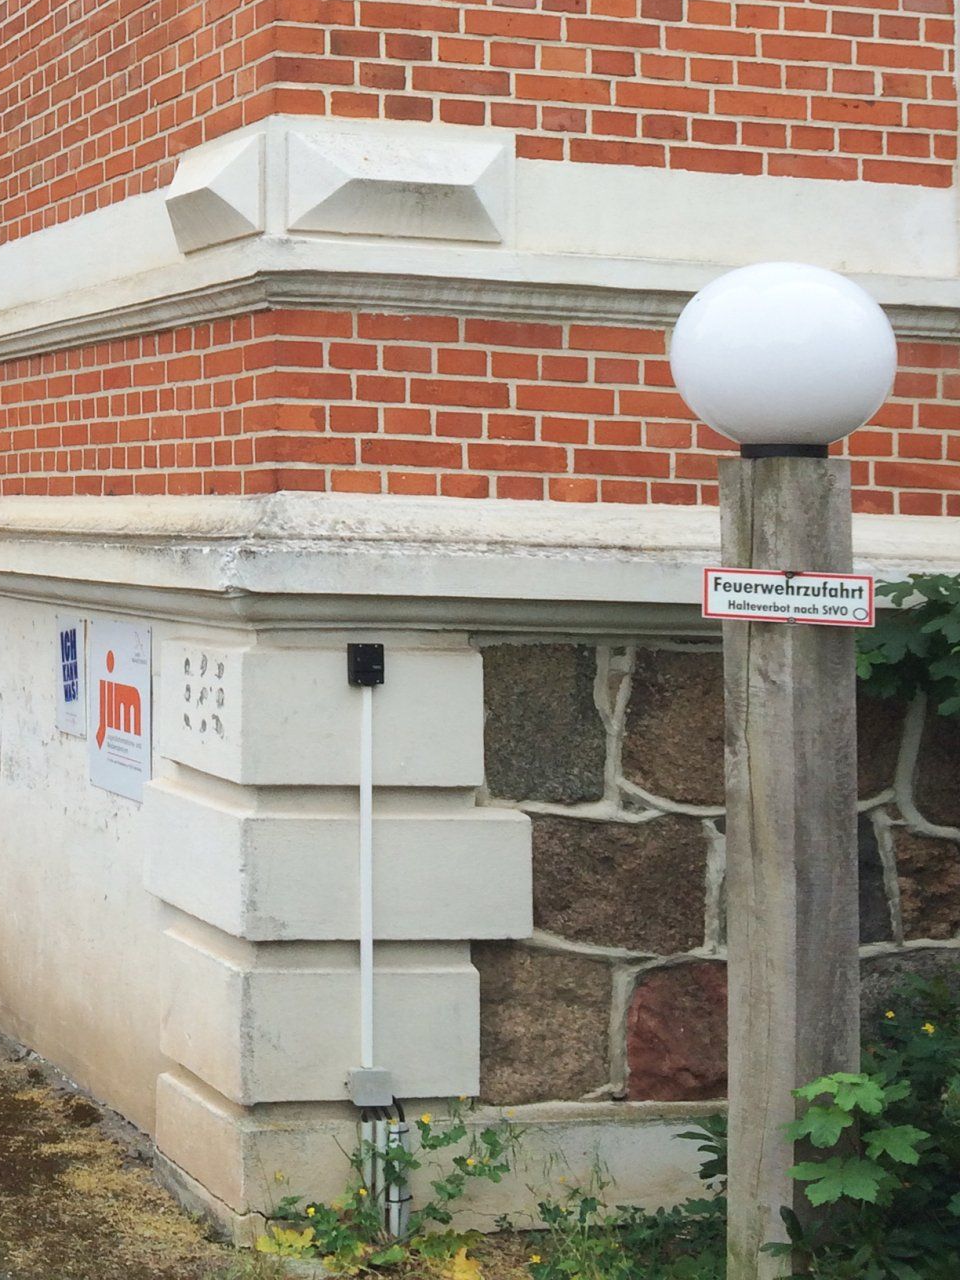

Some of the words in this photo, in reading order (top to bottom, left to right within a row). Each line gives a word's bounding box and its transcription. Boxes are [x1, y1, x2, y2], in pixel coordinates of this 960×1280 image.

[713, 576, 864, 600] Feuerwehrzufahrt
[727, 599, 790, 614] Halteverbot
[793, 602, 819, 615] nach
[822, 606, 848, 616] StVO
[60, 628, 77, 663] ICH
[62, 660, 78, 682] KANN
[63, 680, 78, 702] WAS!
